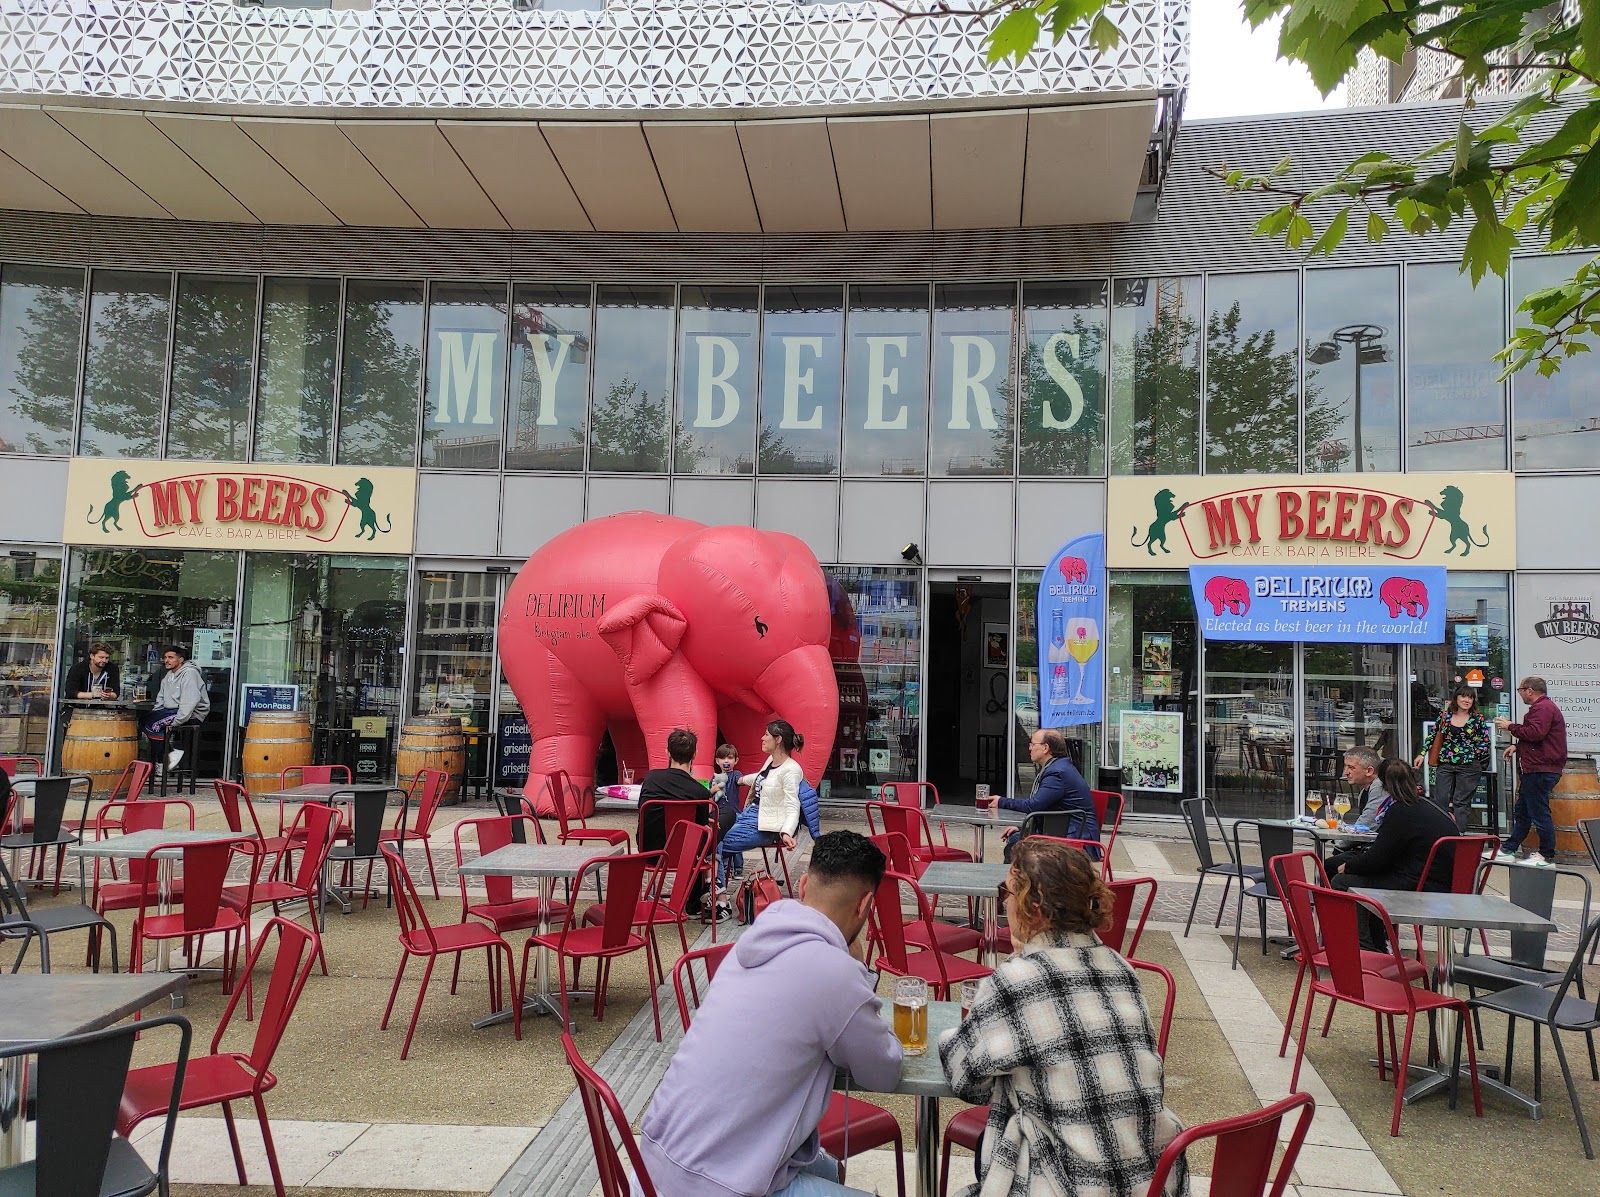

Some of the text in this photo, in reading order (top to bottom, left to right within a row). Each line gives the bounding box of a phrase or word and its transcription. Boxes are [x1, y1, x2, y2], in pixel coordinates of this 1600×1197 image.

[434, 331, 1085, 430] MY BEERS
[149, 477, 330, 532] MY BEERS
[1201, 490, 1415, 550] MY BEERS
[178, 526, 213, 538] CAVE
[215, 528, 223, 538] &
[226, 528, 251, 539] BAR
[255, 529, 264, 539] A
[1231, 545, 1270, 557] CAVE
[1275, 546, 1284, 557] &
[1287, 546, 1315, 557] BAR
[1320, 546, 1331, 557] A
[1049, 585, 1097, 597] DELIRIUM
[1254, 576, 1373, 598] DELIRIUM
[525, 593, 606, 618] DELIRIUM
[1280, 599, 1346, 612] TREMENS
[534, 621, 571, 646] Belgian
[1205, 618, 1428, 634] Elected as best beer in the world!
[1542, 619, 1600, 637] MY BEERS
[1546, 679, 1590, 687] OUTEILLES
